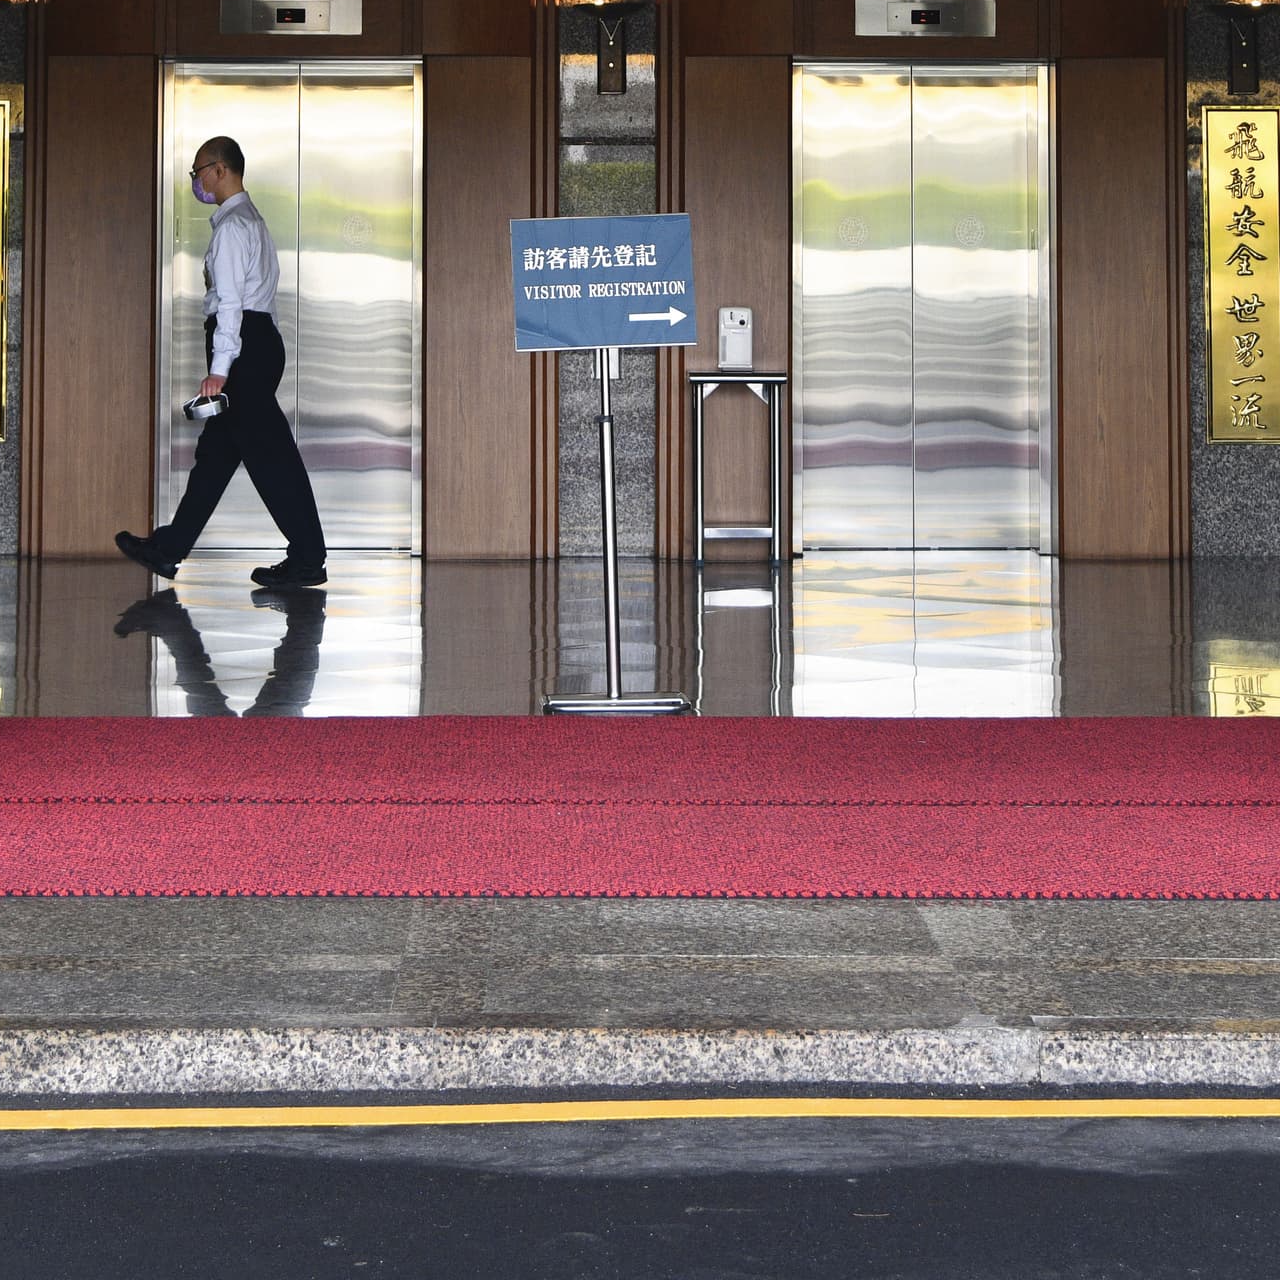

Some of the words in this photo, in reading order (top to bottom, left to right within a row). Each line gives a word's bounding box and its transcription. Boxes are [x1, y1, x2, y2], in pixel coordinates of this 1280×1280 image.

[522, 244, 658, 271] 訪客請先登記
[524, 284, 582, 301] VISITOR
[588, 280, 687, 298] REGISTRATION
